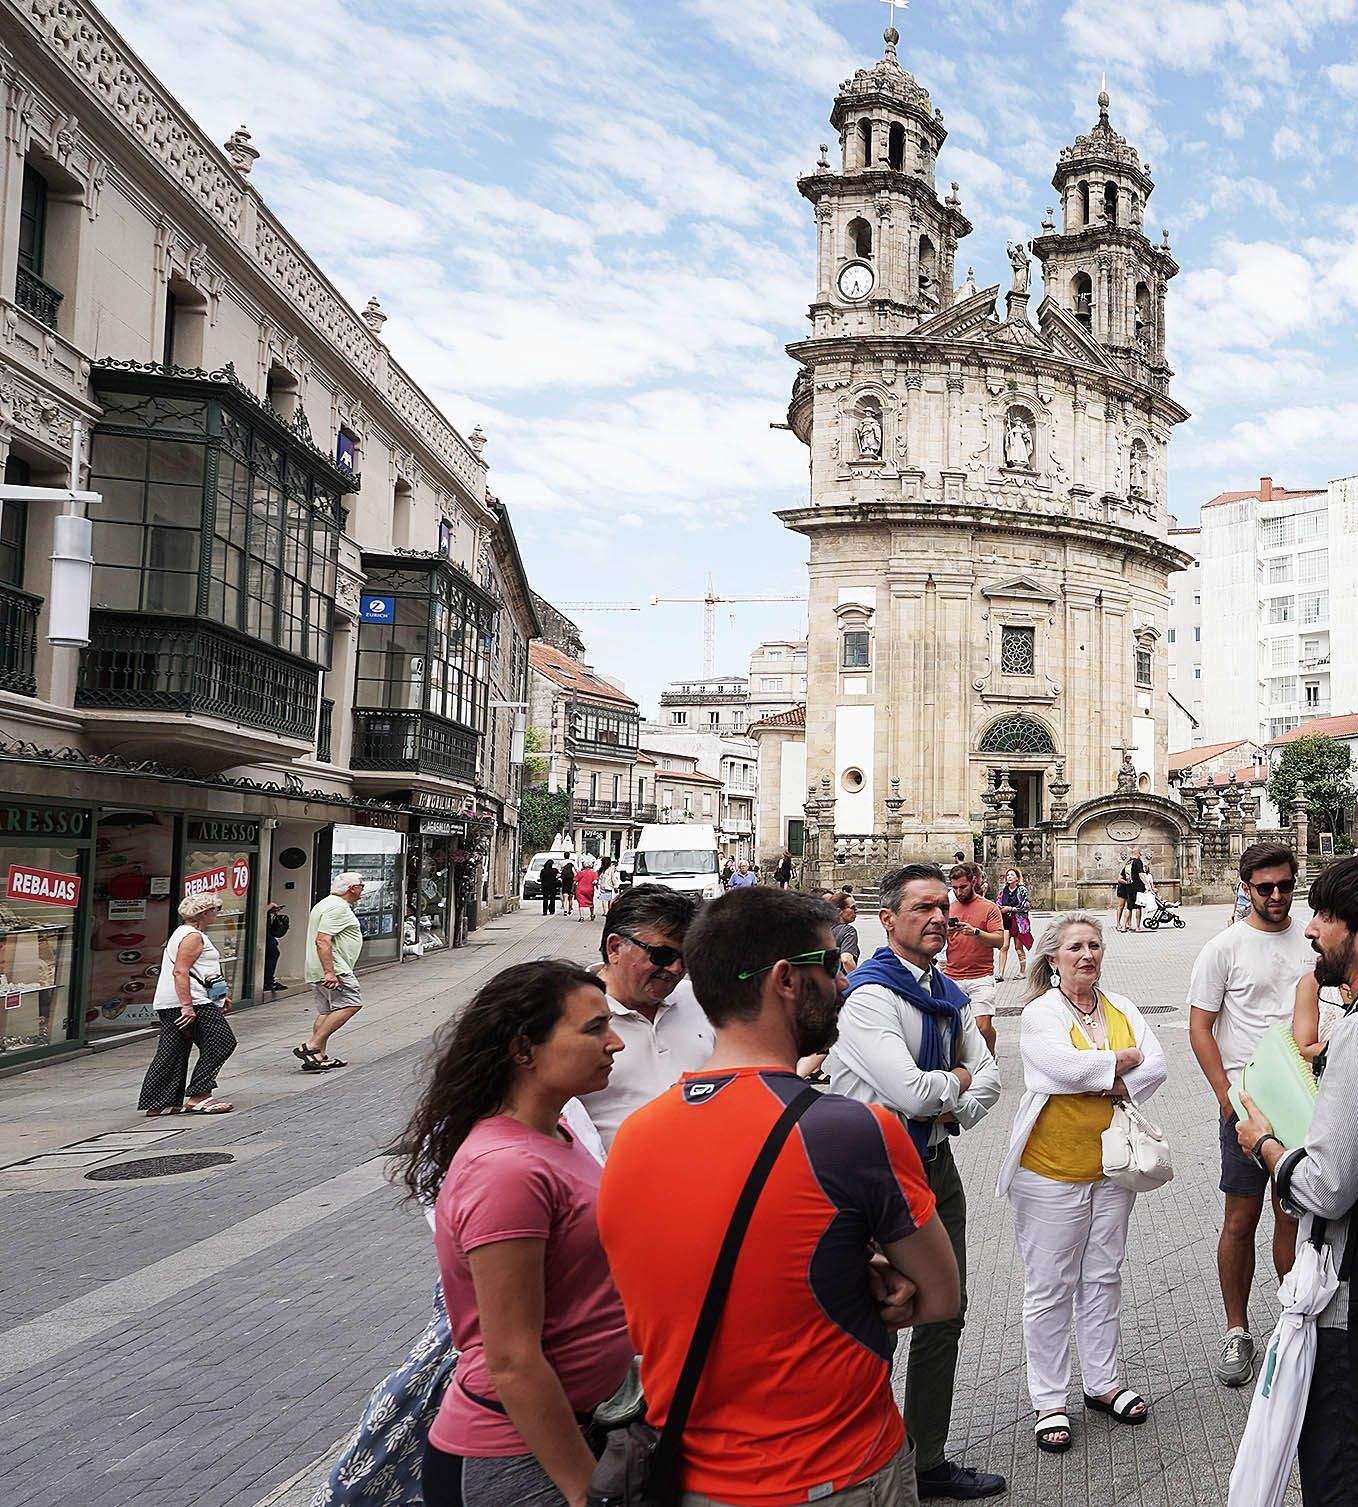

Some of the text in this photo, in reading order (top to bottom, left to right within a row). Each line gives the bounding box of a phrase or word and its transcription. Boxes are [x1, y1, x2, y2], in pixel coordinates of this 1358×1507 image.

[0, 808, 84, 834] RESSO
[199, 821, 255, 841] ARESSO
[12, 872, 76, 901] REBAJAS
[184, 870, 226, 897] REBAJAS
[233, 865, 248, 889] 70
